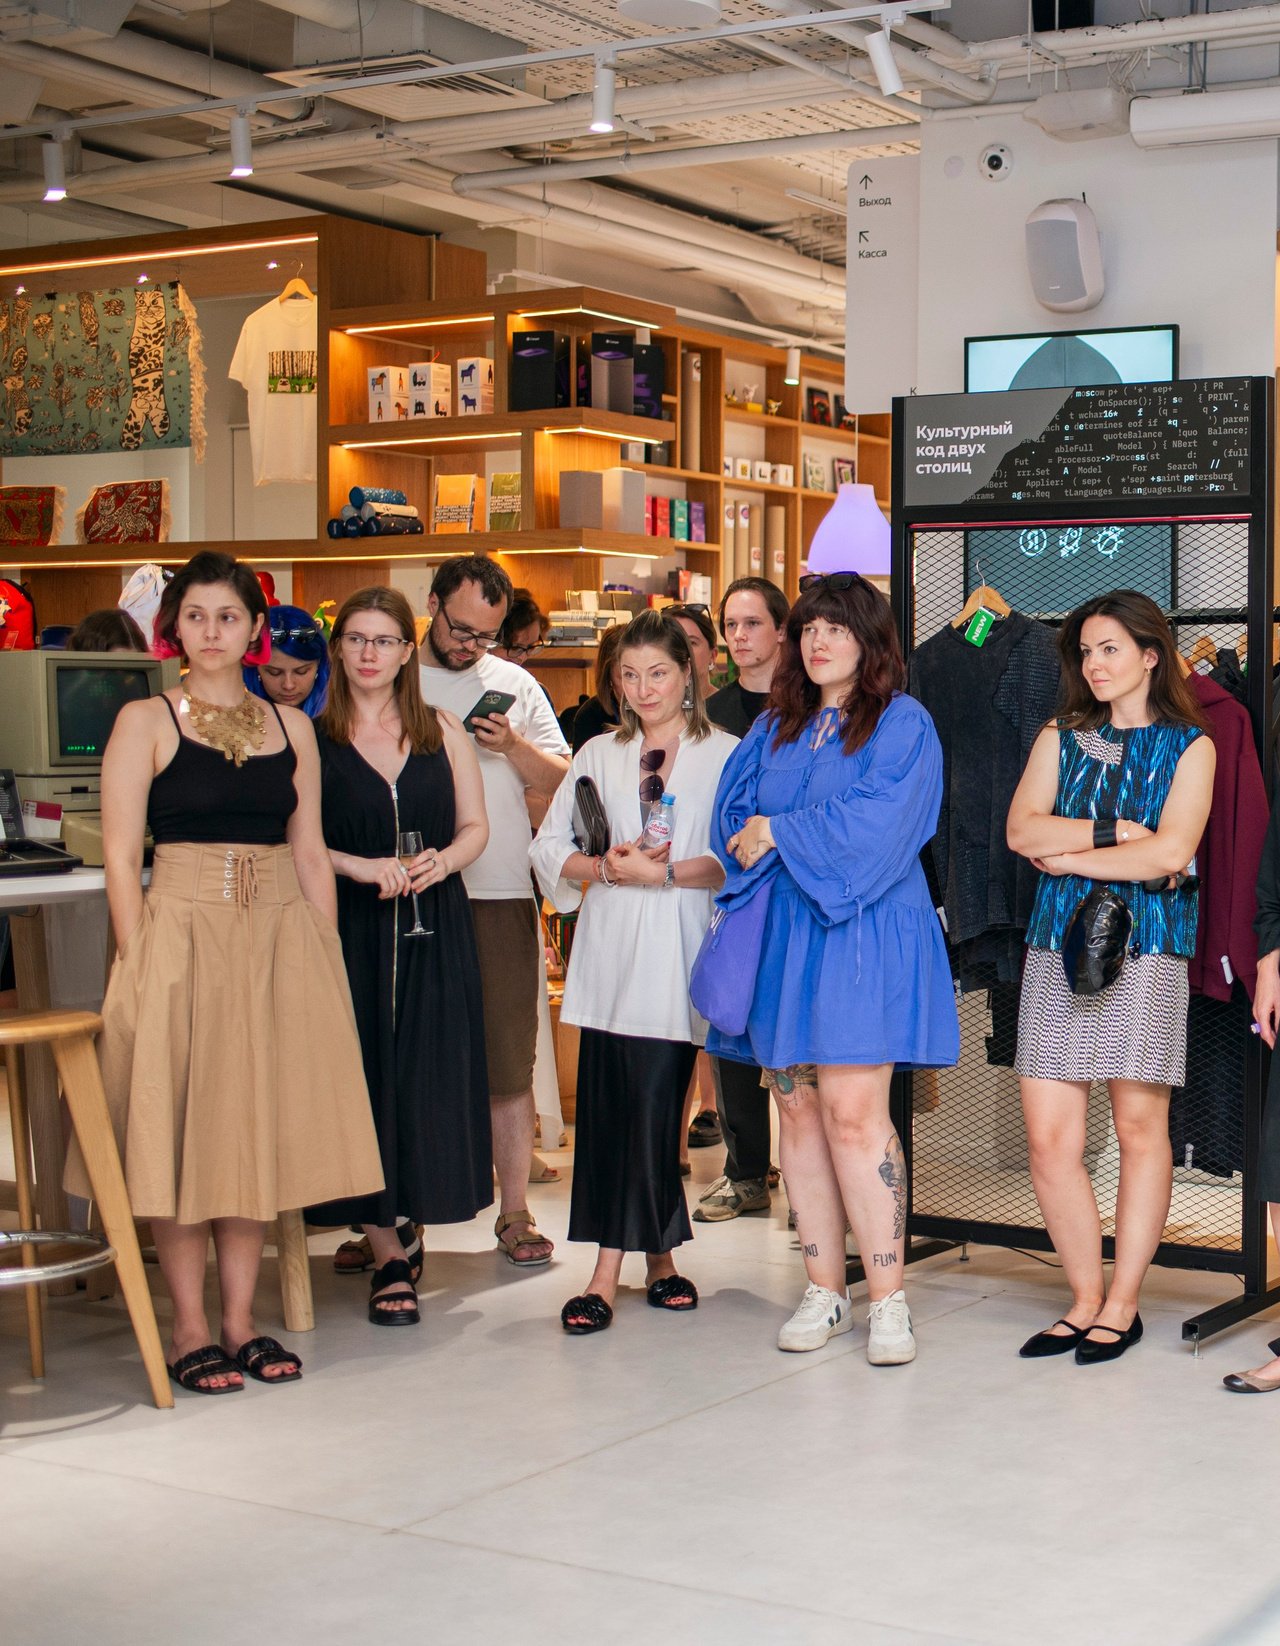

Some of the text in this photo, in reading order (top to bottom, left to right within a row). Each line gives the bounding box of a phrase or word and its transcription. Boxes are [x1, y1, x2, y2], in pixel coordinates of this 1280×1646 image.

[859, 197, 892, 207] Выход
[858, 249, 887, 259] Касса
[1076, 389, 1105, 398] moscow
[1108, 388, 1118, 398] p+
[1152, 386, 1173, 395] sep+
[1213, 382, 1224, 390] PR
[1098, 397, 1152, 407] OnSpaces();
[1172, 396, 1183, 404] se
[916, 420, 1013, 441] Культурный
[1073, 421, 1123, 431] determines
[1127, 419, 1143, 429] eof
[1147, 418, 1158, 427] if
[1222, 415, 1249, 425] paren
[1102, 430, 1163, 442] quoteBalance
[1178, 428, 1198, 438] !quo
[1207, 426, 1248, 436] Balance;
[916, 443, 986, 458] код двух
[1054, 444, 1094, 454] ableFull
[1117, 442, 1143, 450] Model
[1172, 439, 1198, 448] NBert
[1014, 457, 1029, 466] Fut
[1057, 452, 1160, 464] Processor->Process(st
[1223, 448, 1249, 459] (full
[916, 462, 972, 474] столиц
[1016, 468, 1051, 477] rrr.Set
[1062, 466, 1070, 475] A
[1077, 465, 1102, 474] Model
[1132, 464, 1148, 473] For
[1167, 462, 1198, 471] Search
[1026, 479, 1064, 488] Applier:
[1081, 477, 1102, 486] sep+
[1150, 473, 1181, 483] +saint
[1183, 471, 1233, 484] petersburg
[1011, 490, 1051, 501] ages.Req
[1064, 487, 1113, 497] tLanguages
[1121, 484, 1193, 496] &Languages.Use
[971, 615, 987, 642] NEW
[804, 1243, 819, 1258] NO
[873, 1250, 897, 1267] FUN
